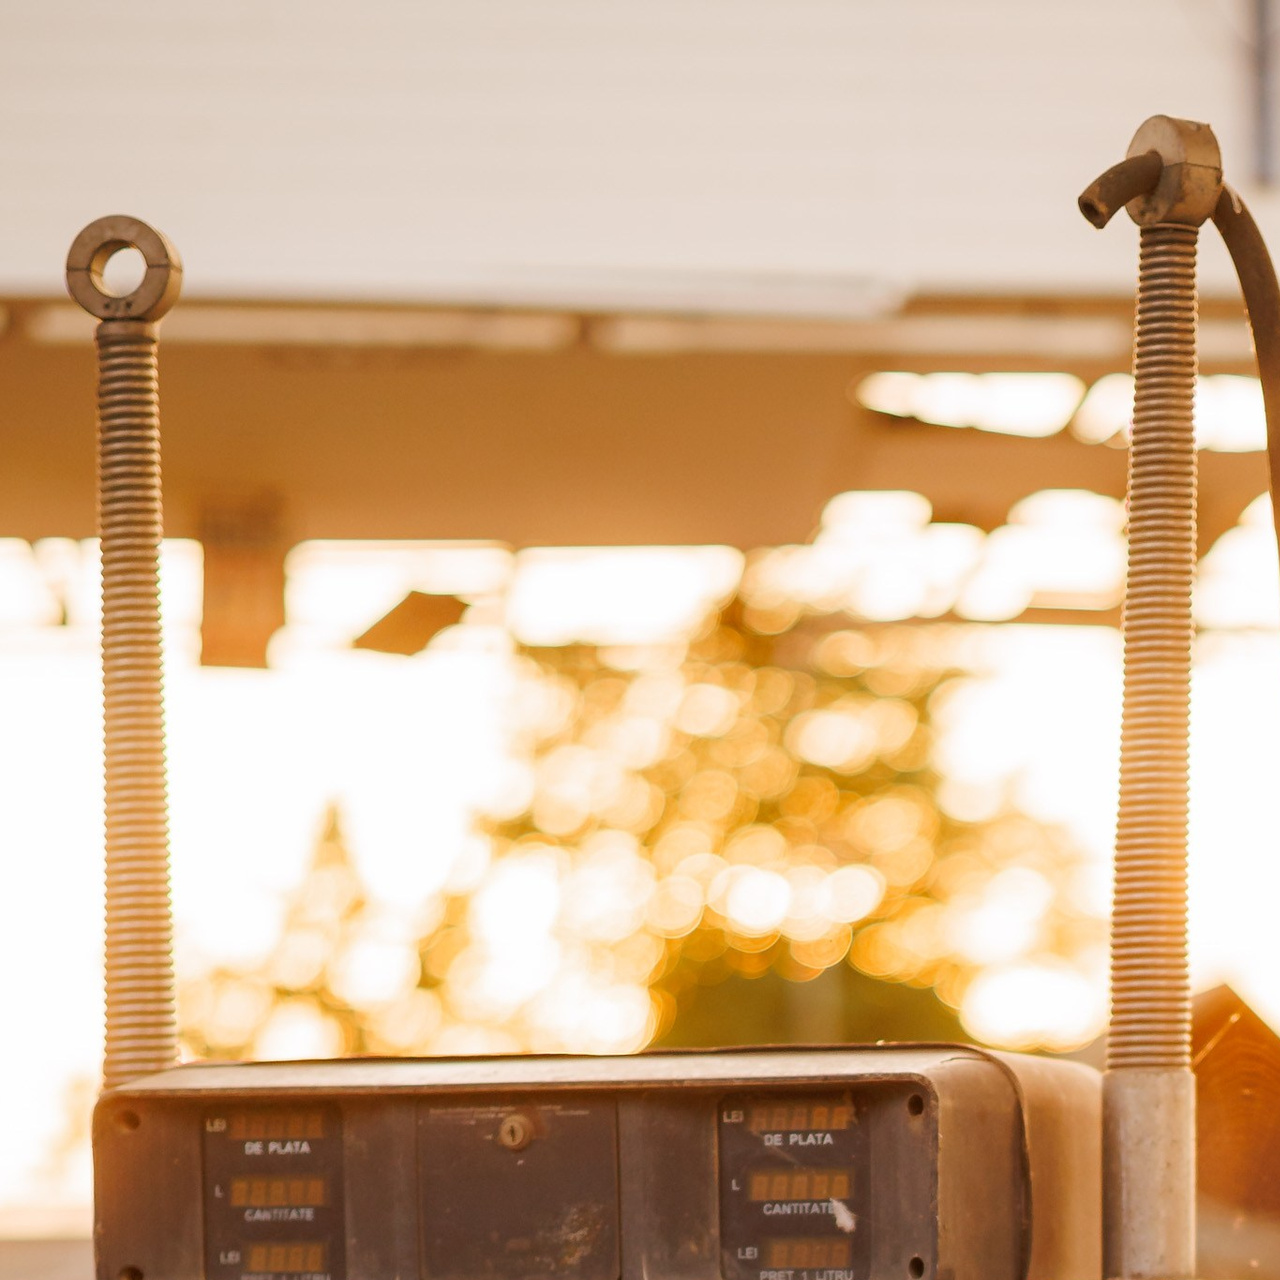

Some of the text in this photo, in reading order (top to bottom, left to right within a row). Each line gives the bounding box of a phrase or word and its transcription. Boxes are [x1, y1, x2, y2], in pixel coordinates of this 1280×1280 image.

[723, 1110, 743, 1123] LEI
[764, 1133, 834, 1146] DE PLATA
[268, 1141, 311, 1155] PLATA
[731, 1179, 740, 1191] L
[244, 1208, 314, 1222] CANTITATE
[763, 1203, 837, 1215] CANTITATE
[738, 1247, 758, 1259] LEI
